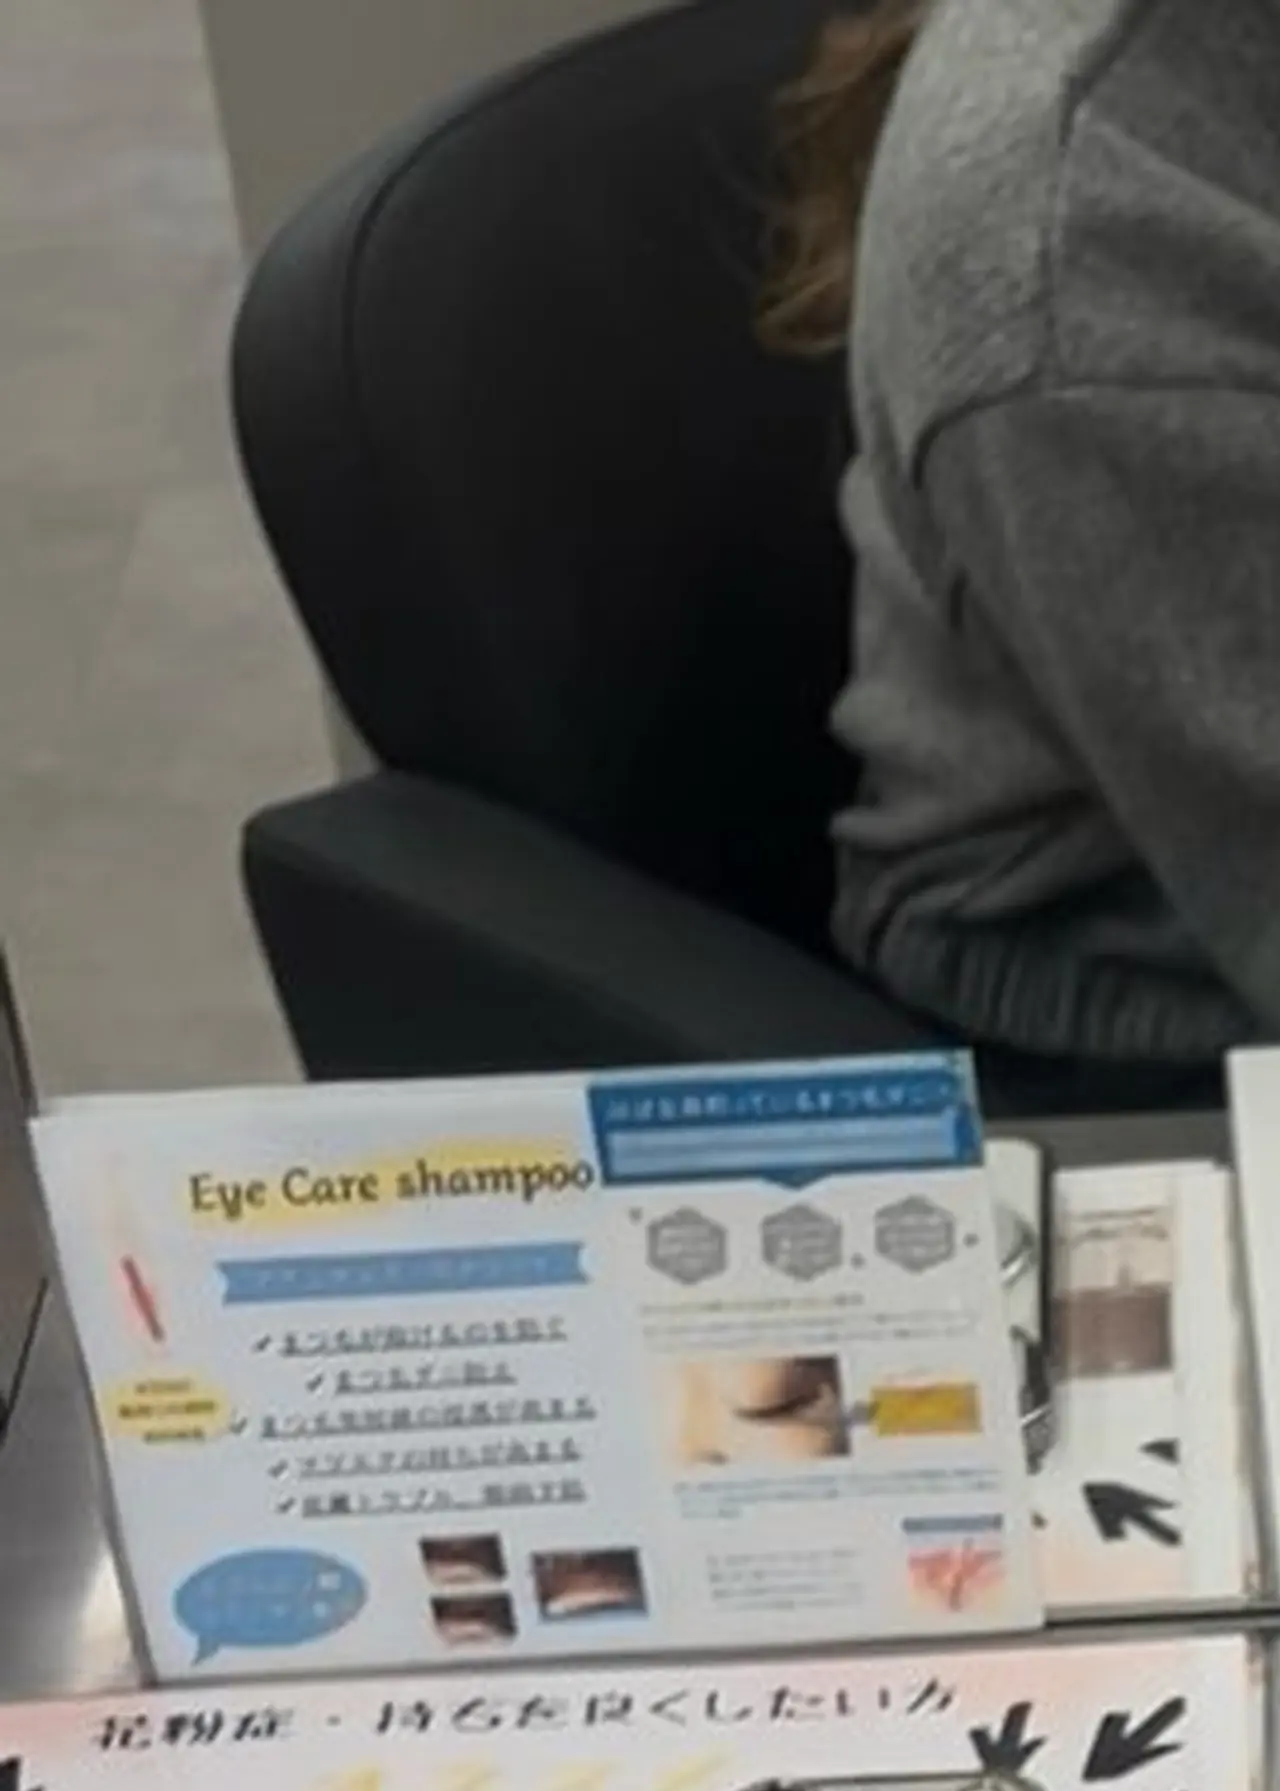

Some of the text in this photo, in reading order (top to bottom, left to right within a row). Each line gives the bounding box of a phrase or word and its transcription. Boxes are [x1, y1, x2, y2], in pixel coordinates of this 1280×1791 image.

[188, 1158, 594, 1222] Eye Care shampoo
[95, 1678, 957, 1750] 花粉症・持ちを良くしたい方
